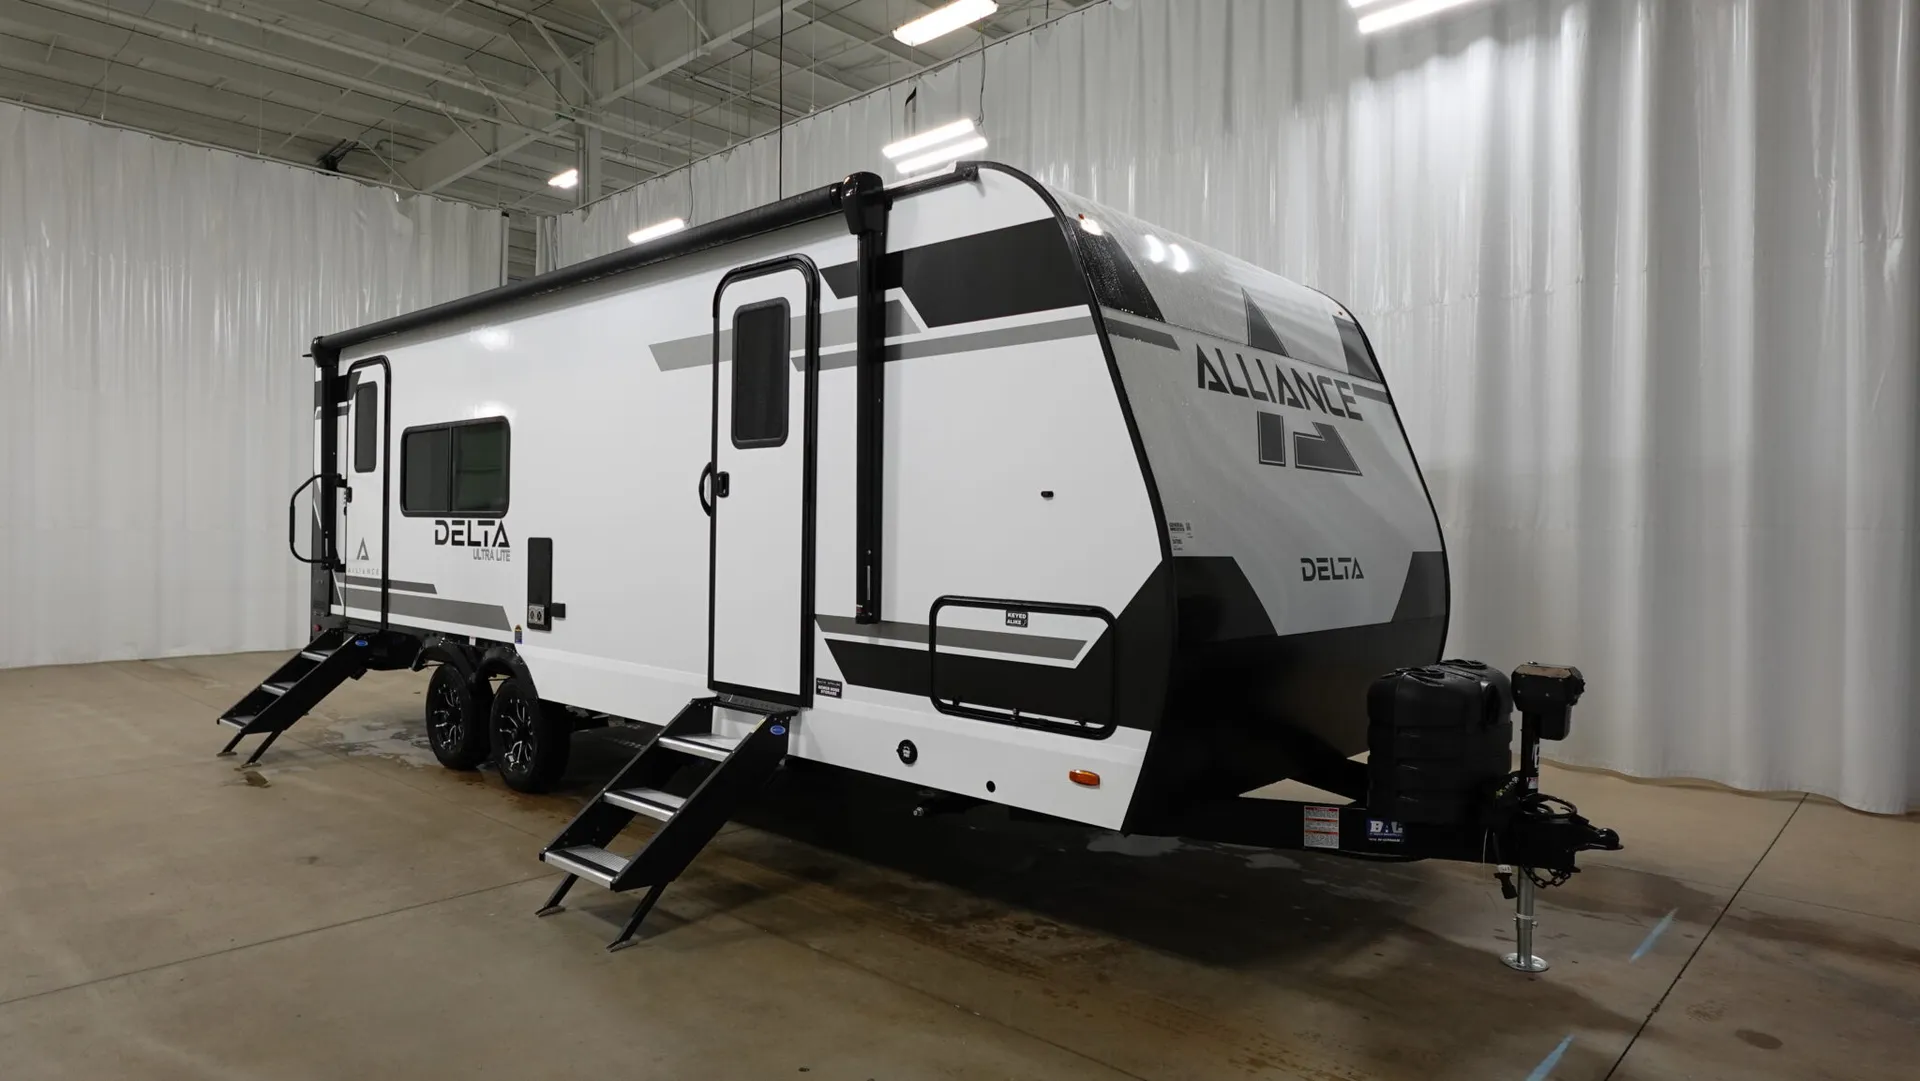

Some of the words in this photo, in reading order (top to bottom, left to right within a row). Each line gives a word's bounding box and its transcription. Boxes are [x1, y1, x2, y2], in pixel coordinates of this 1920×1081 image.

[1196, 343, 1364, 422] ALLIANCE
[434, 519, 511, 548] DELTA
[473, 548, 495, 561] ULTRA
[496, 549, 511, 562] LITE
[1300, 557, 1364, 582] DELTA
